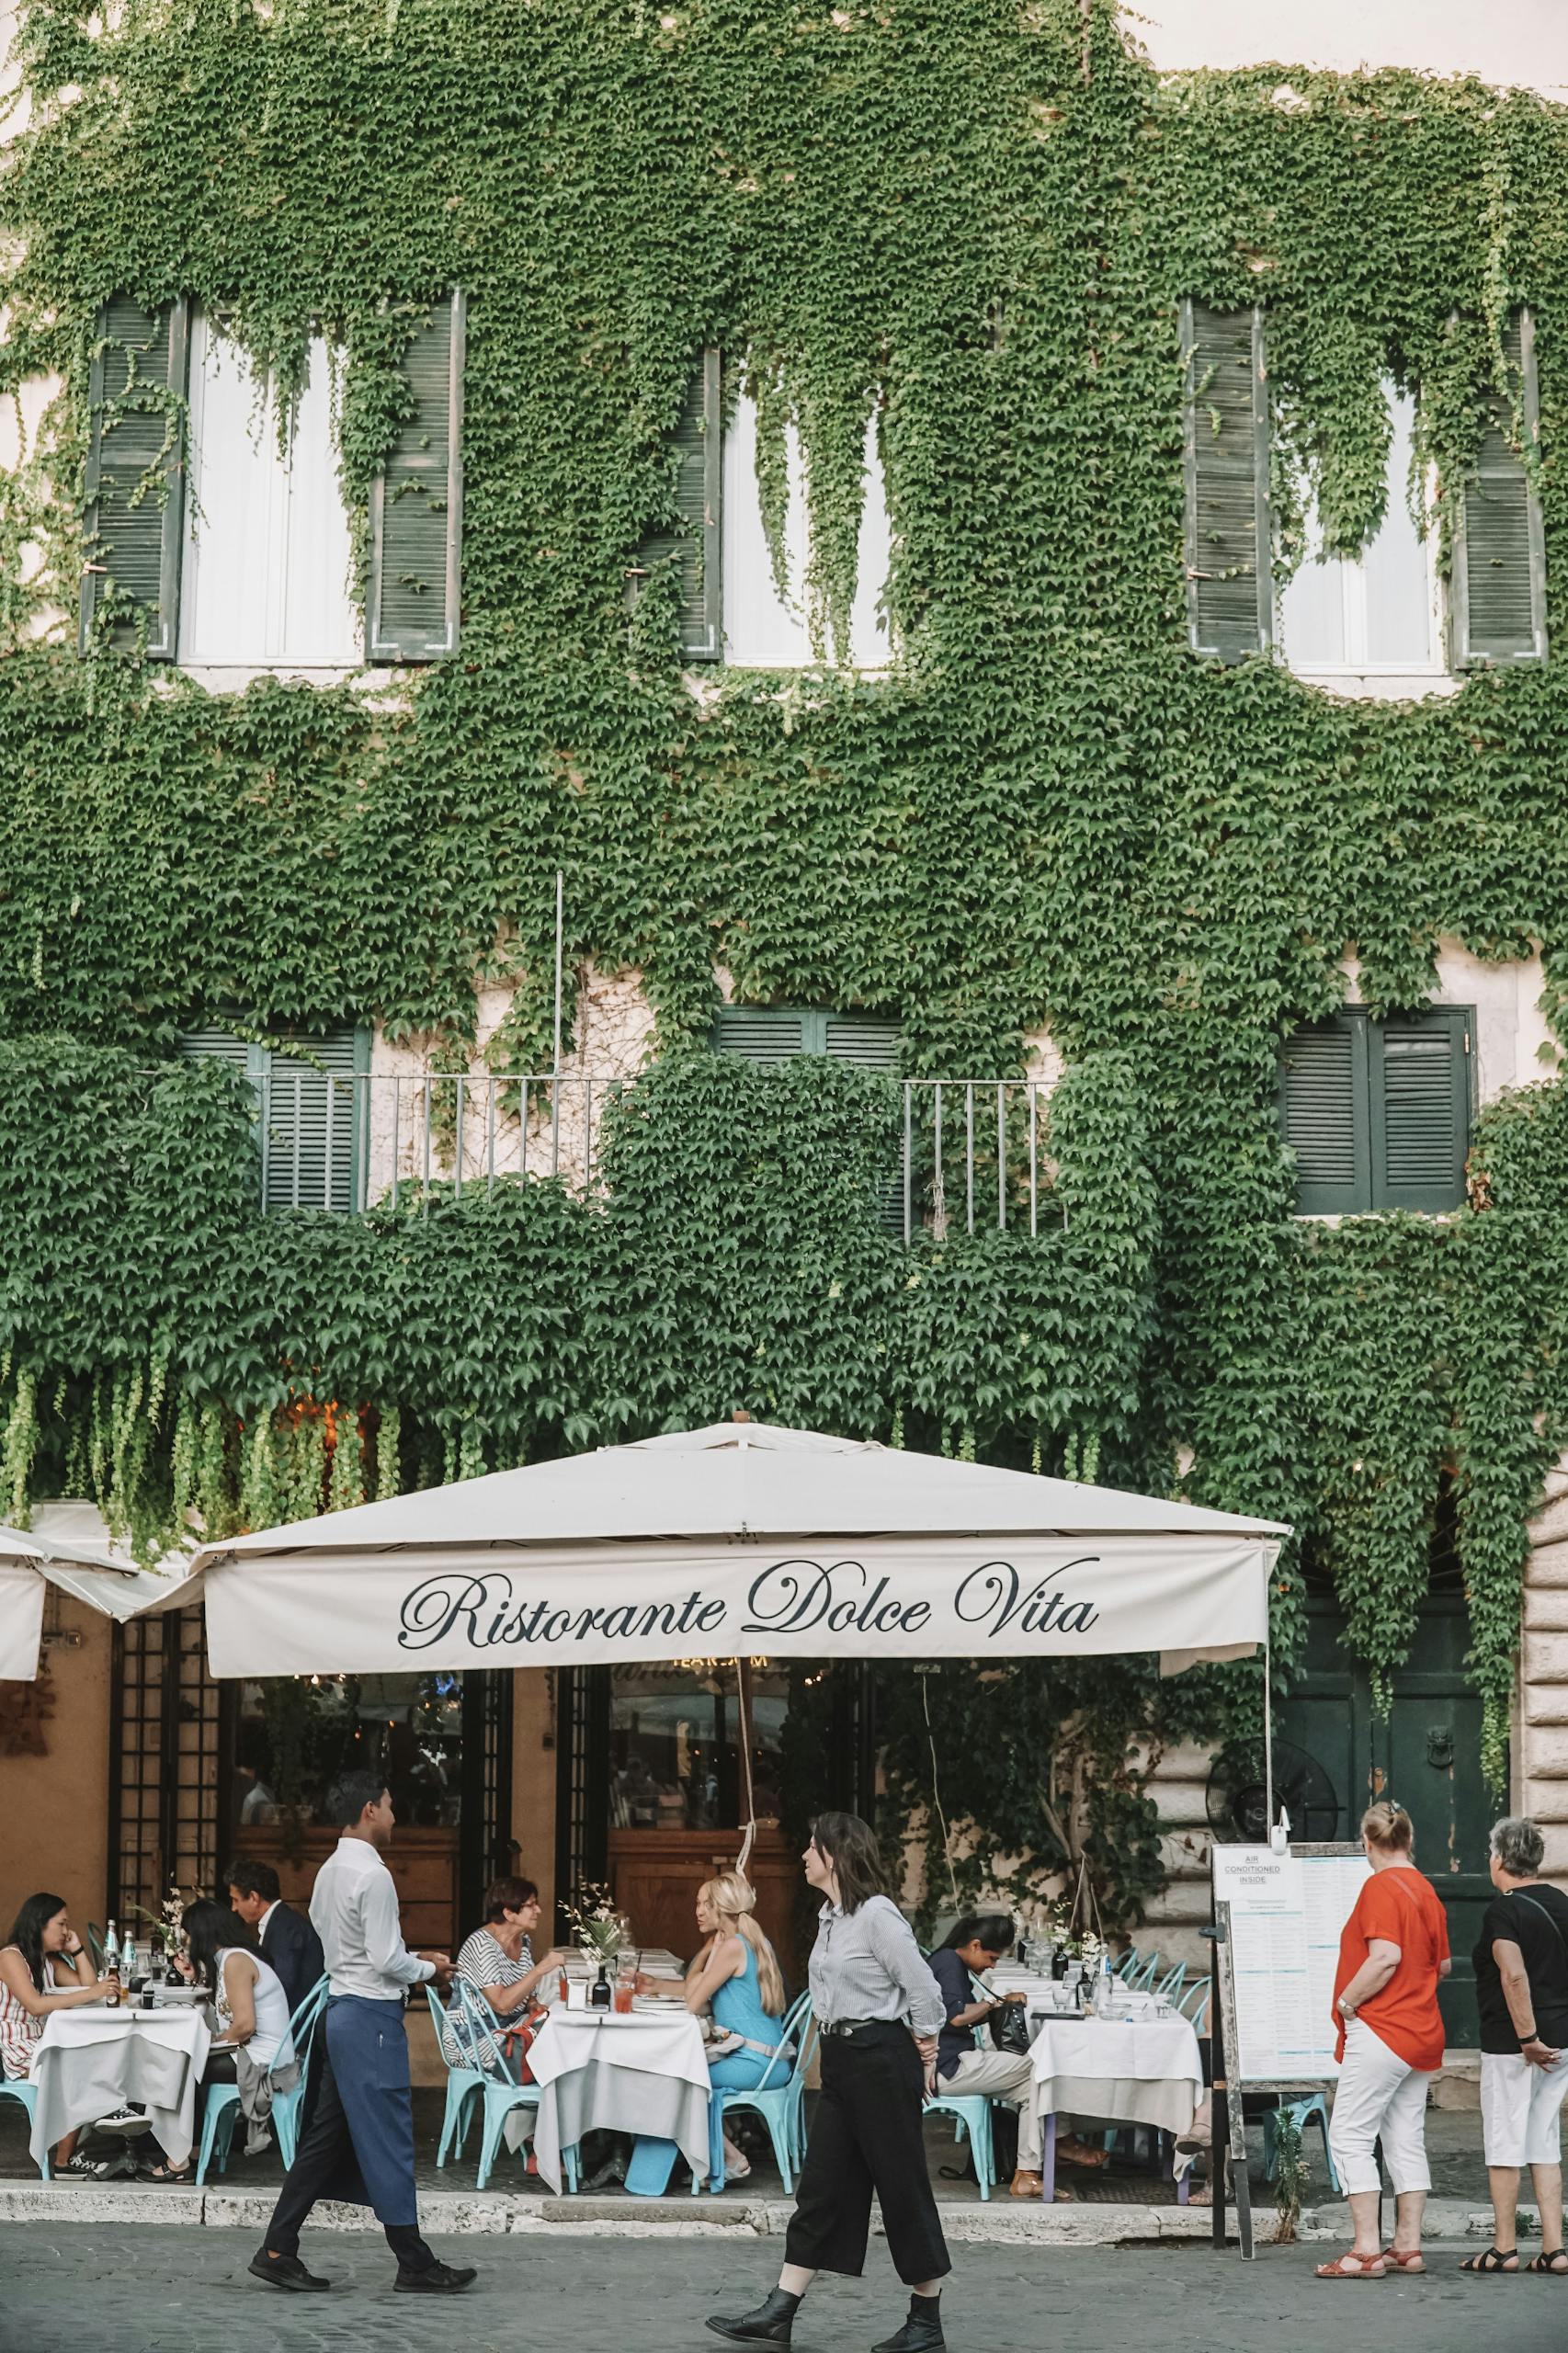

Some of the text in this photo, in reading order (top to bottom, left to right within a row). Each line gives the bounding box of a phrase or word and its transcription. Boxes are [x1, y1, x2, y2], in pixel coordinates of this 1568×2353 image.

[397, 1556, 1101, 1649] Ristorante Dolce Vita
